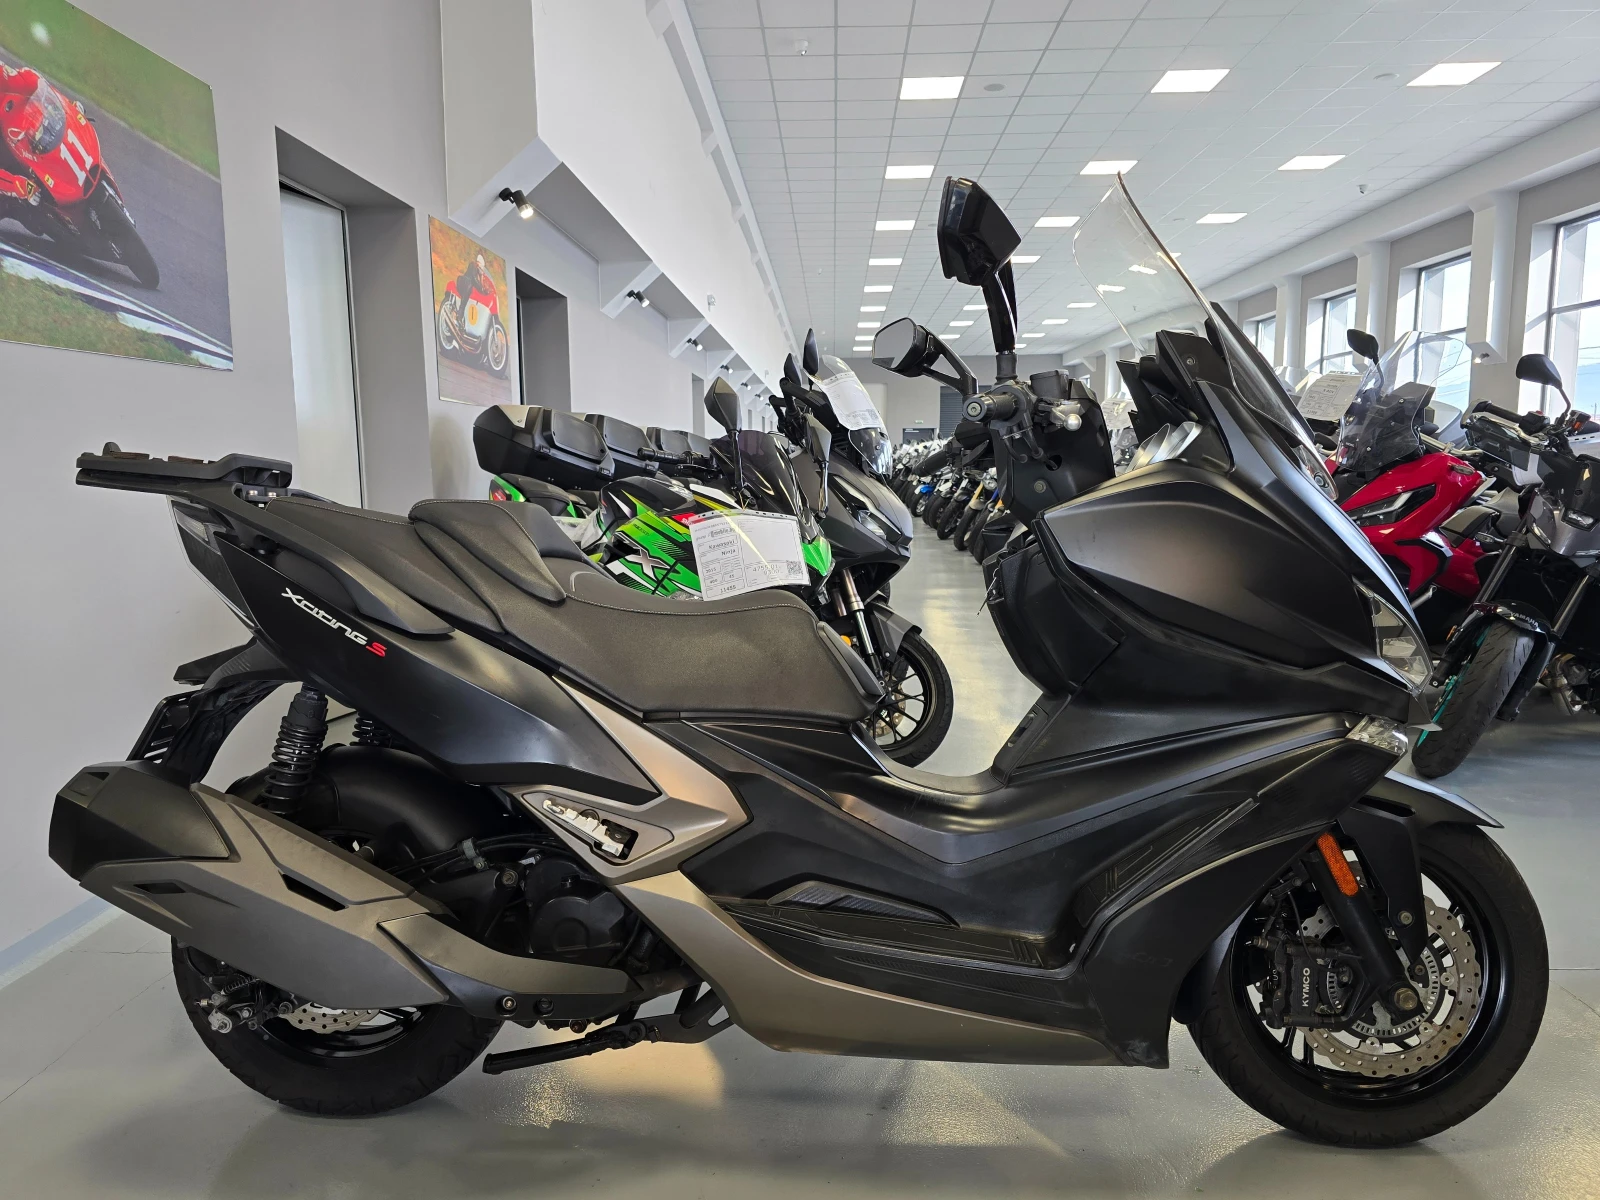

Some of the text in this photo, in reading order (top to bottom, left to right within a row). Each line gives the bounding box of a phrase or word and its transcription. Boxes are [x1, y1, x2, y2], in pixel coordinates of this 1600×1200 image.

[60, 128, 94, 188] 11
[708, 539, 735, 550] Kawasaki
[1510, 611, 1539, 628] YAMAHA
[1301, 967, 1311, 1007] KYMCO
